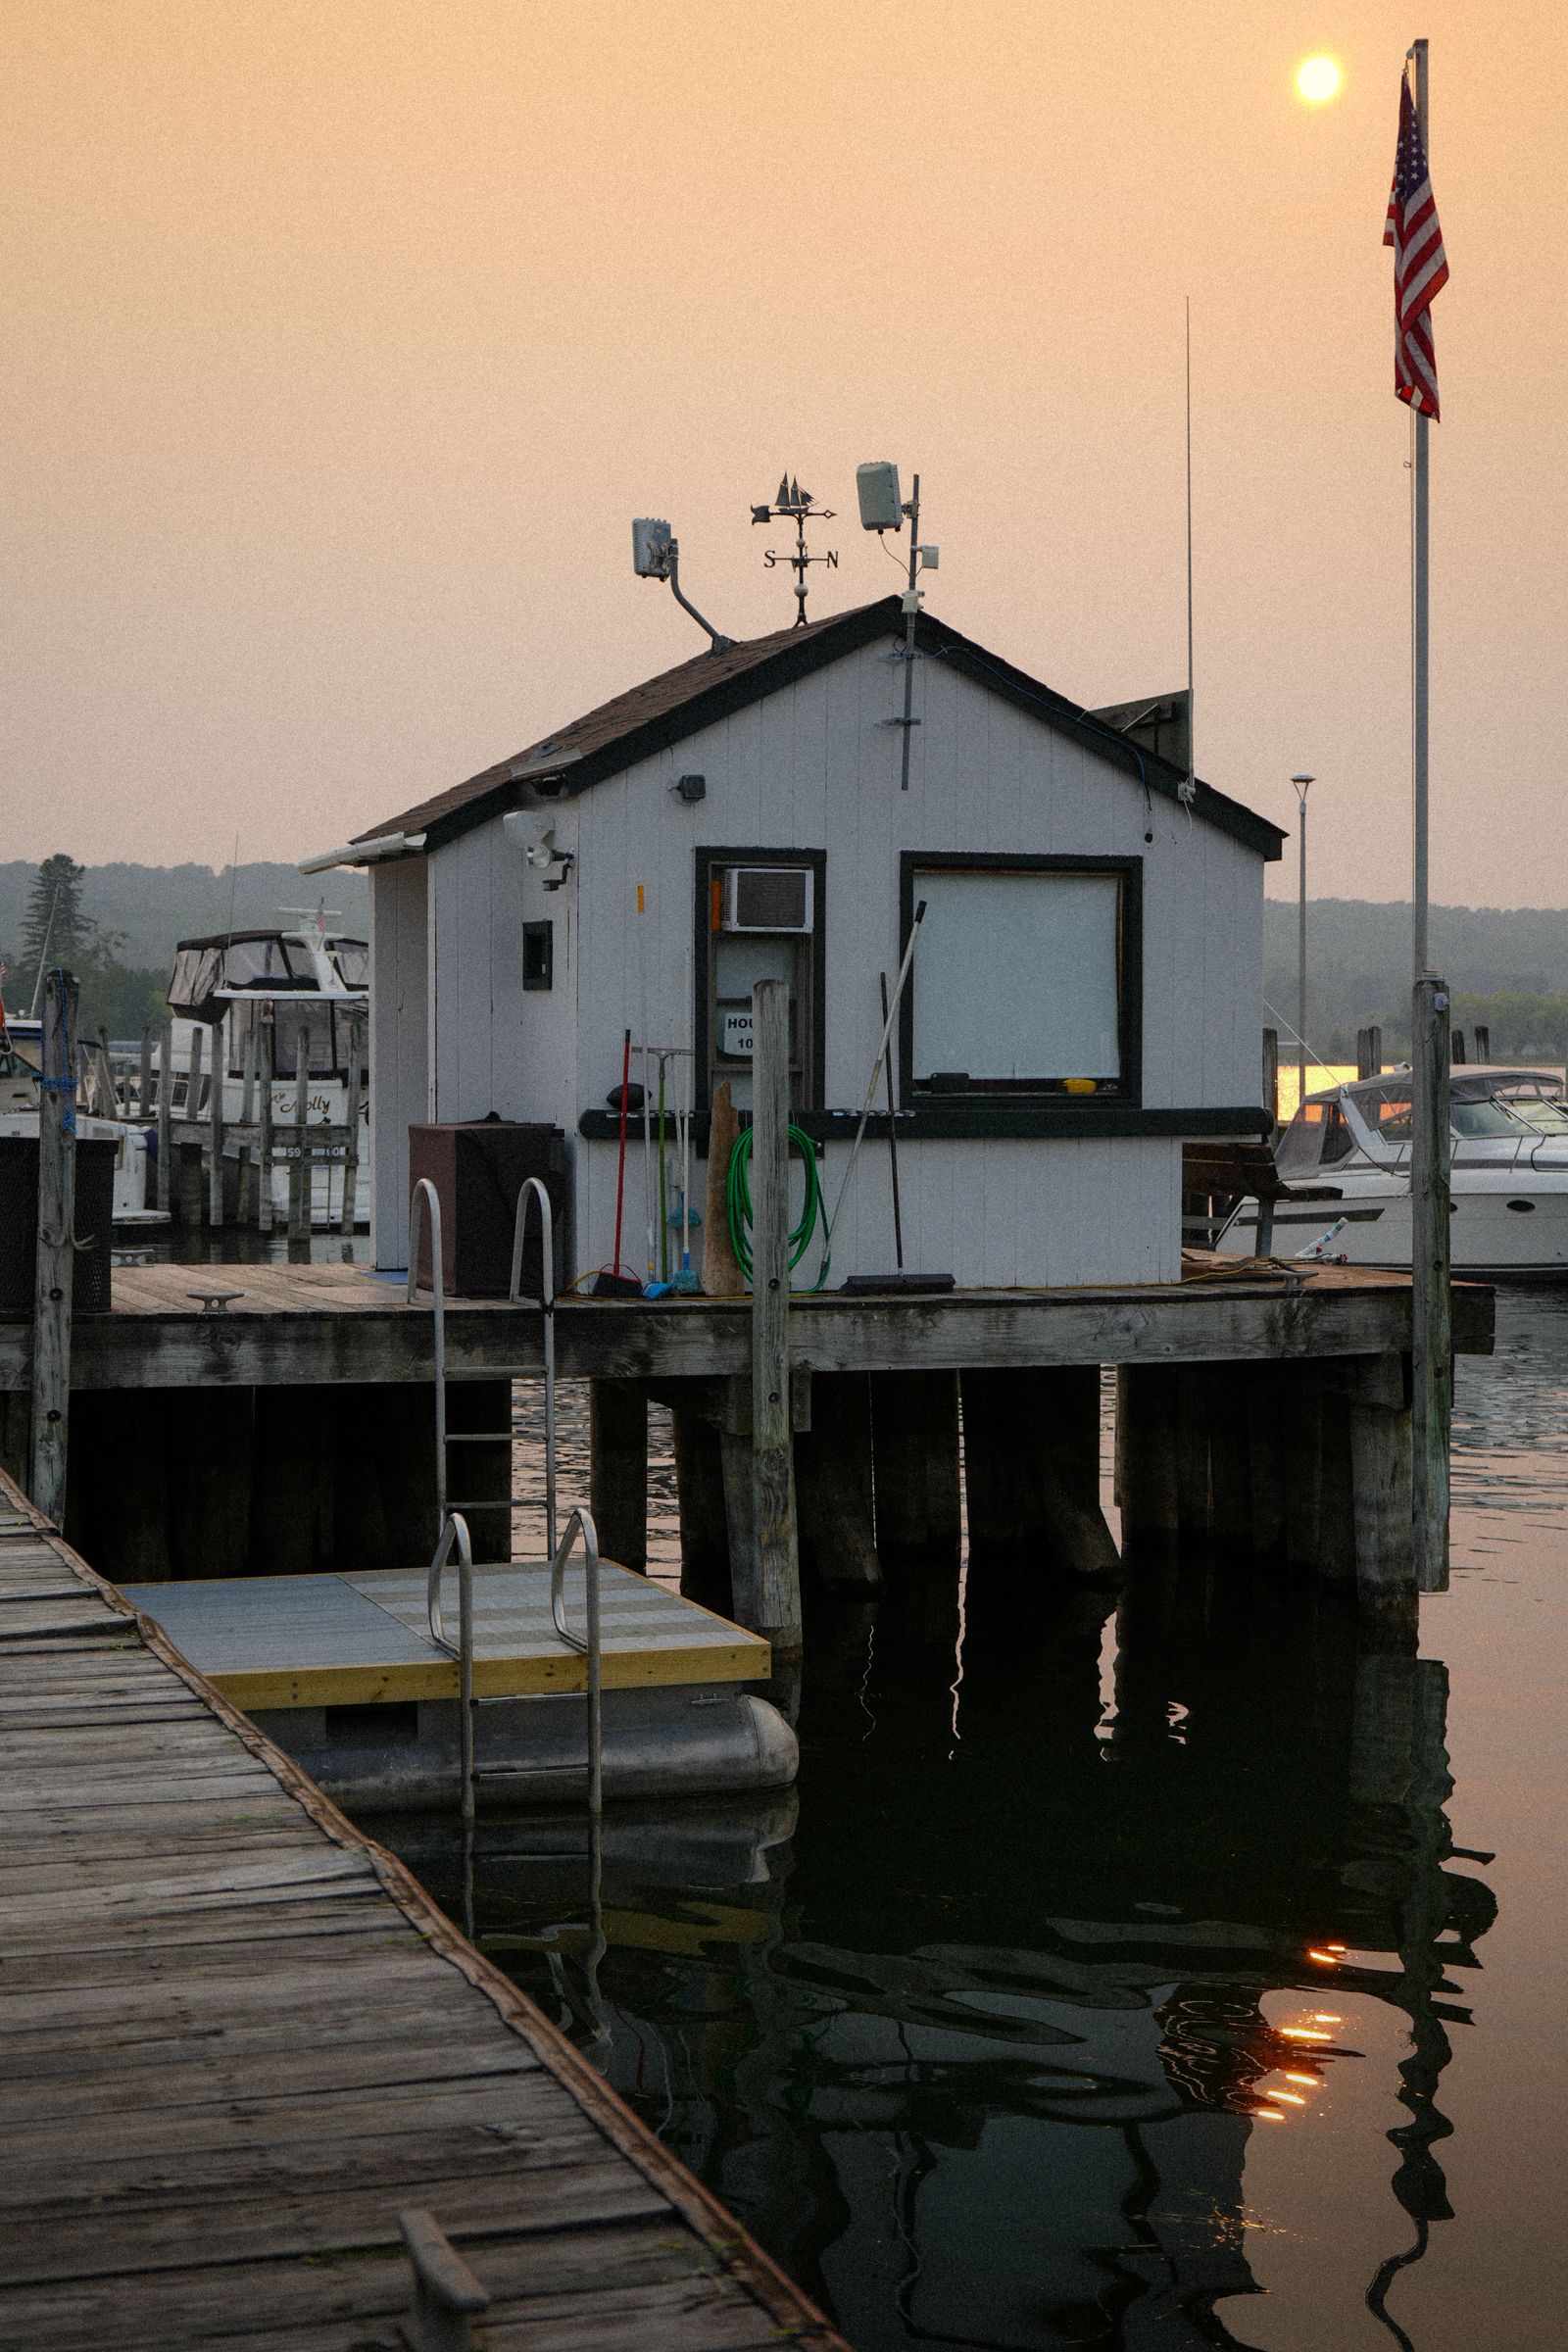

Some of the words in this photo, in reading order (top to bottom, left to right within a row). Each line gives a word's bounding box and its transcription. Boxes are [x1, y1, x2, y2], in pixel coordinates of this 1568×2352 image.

[763, 550, 776, 568] S
[826, 551, 839, 568] N
[737, 1038, 754, 1050] 10
[287, 1147, 302, 1157] 59
